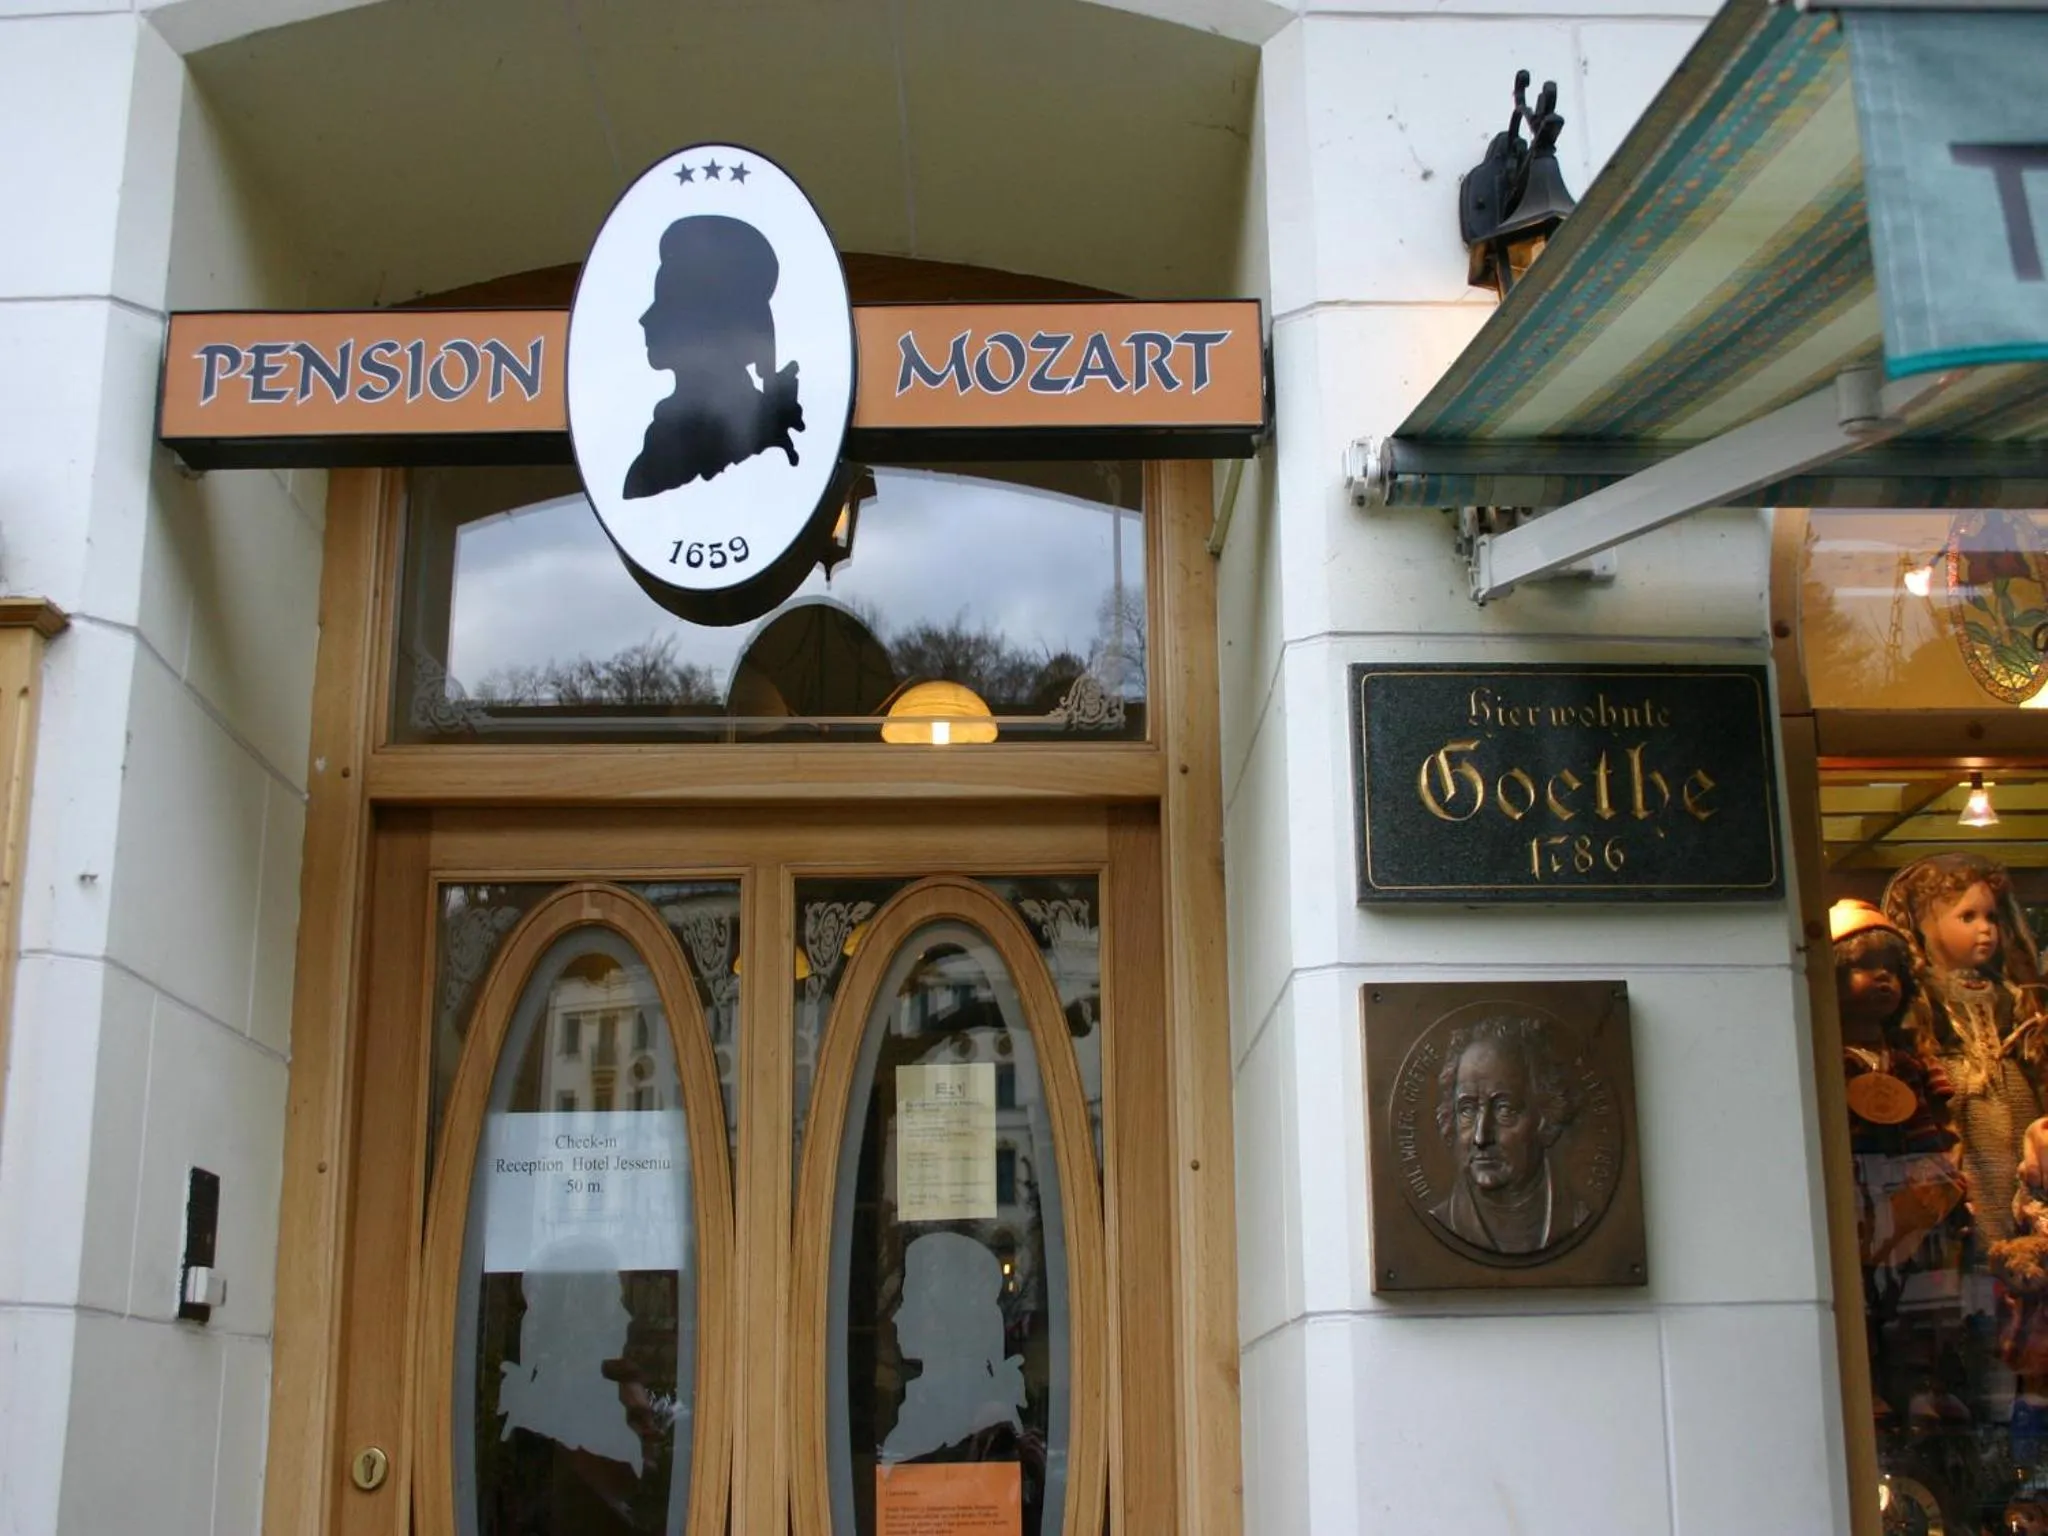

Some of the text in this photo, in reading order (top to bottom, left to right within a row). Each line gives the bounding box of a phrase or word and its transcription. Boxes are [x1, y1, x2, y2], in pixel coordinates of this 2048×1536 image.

[192, 329, 1232, 407] PENSION MOZART
[669, 536, 749, 569] 1659
[1468, 686, 1672, 738] Hier wohnte
[1418, 740, 1719, 839] Goethe
[1529, 834, 1626, 881] 1786
[555, 1134, 617, 1150] Check-in
[496, 1158, 564, 1176] Reception
[572, 1156, 610, 1172] Hotel
[566, 1179, 583, 1194] 50
